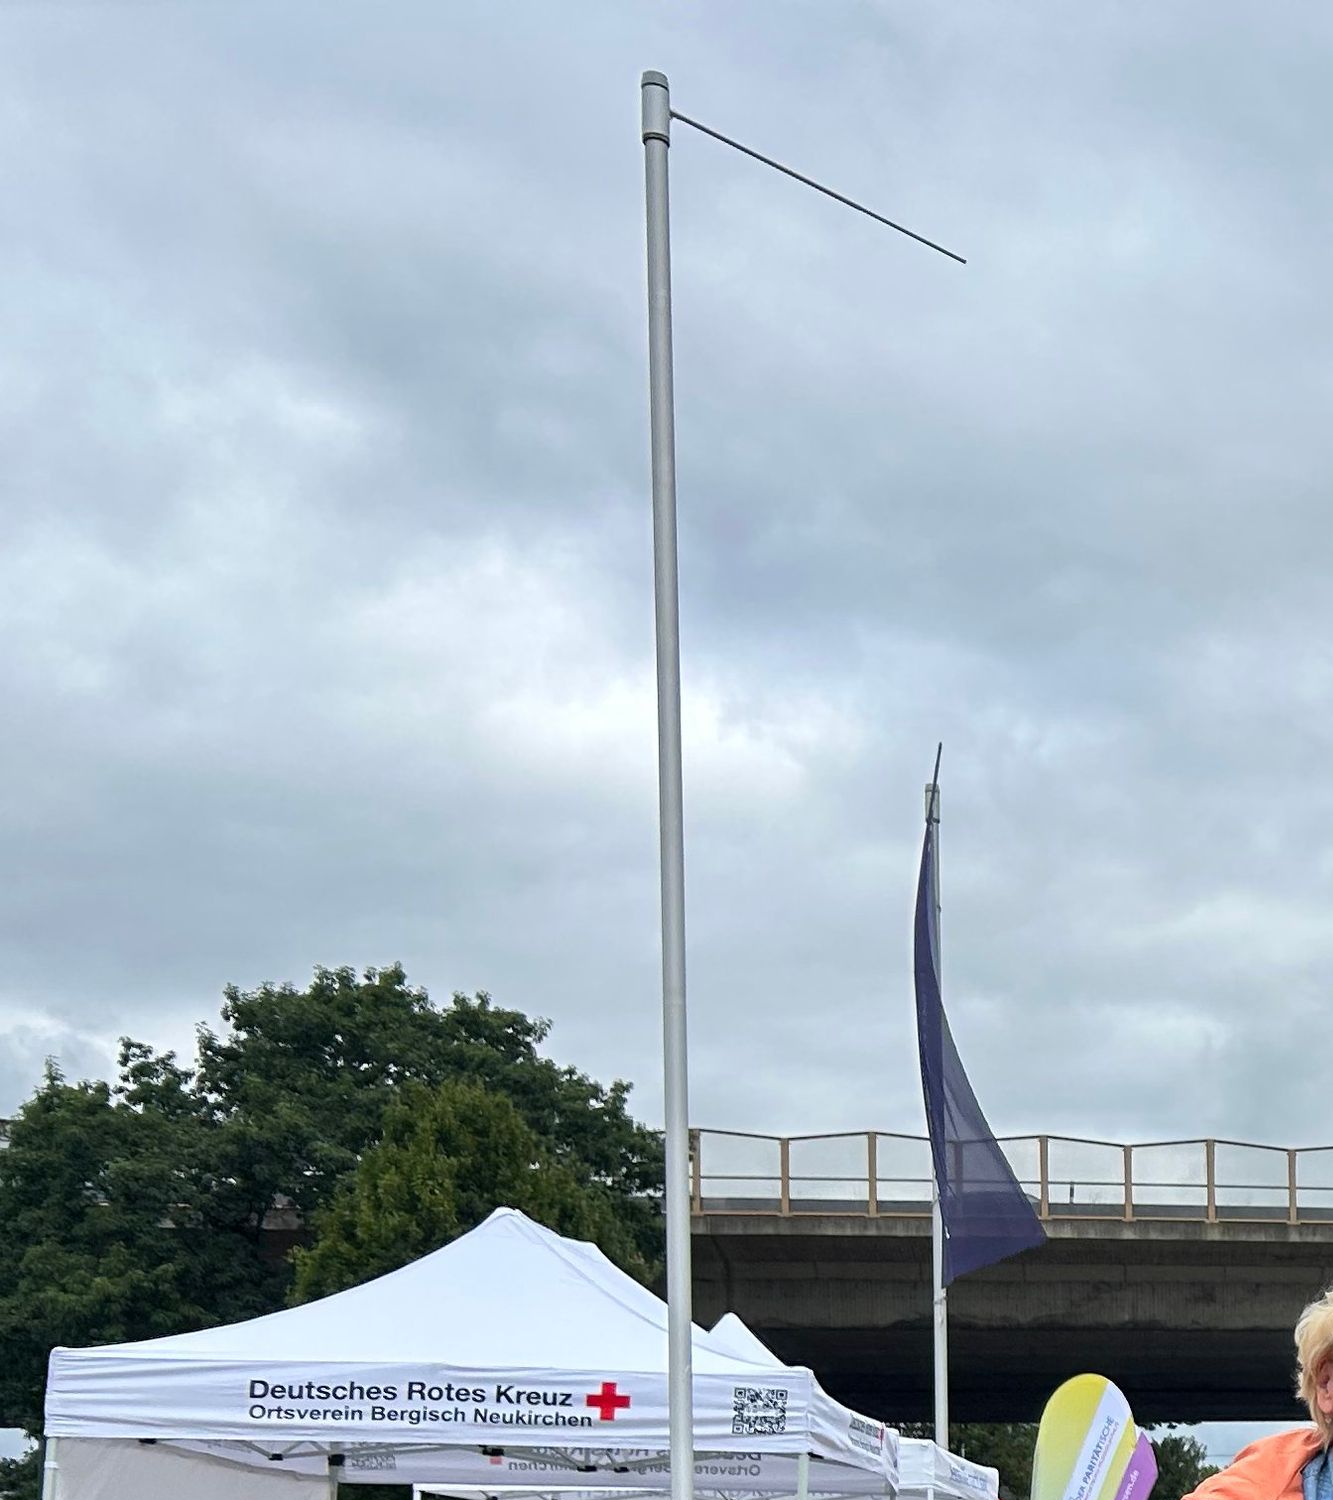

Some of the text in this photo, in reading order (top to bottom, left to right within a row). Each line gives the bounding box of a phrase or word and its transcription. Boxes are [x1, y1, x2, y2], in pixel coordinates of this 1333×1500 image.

[249, 1379, 573, 1408] Deutsches Rotes Kreuz
[249, 1404, 593, 1428] Ortsverein Bergisch Neukirchen
